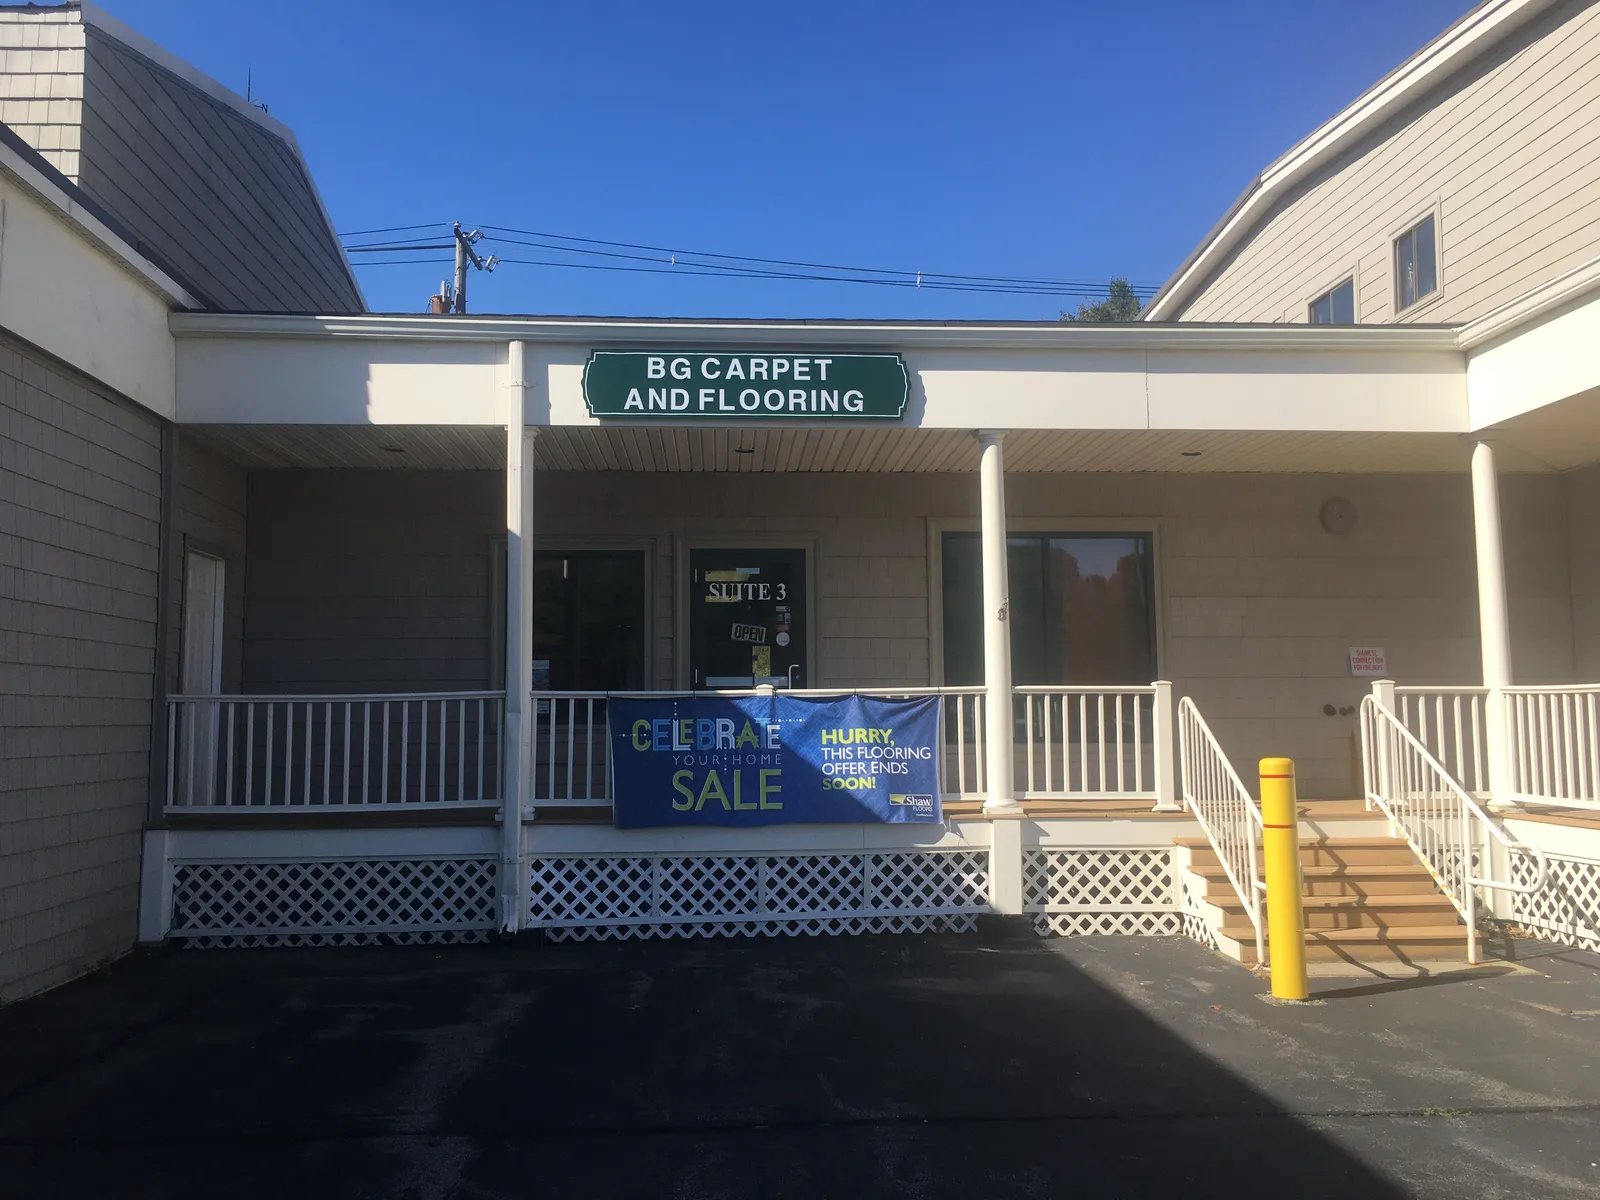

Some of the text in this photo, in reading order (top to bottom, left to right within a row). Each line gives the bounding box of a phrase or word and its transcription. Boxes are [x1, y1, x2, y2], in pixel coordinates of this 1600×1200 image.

[647, 357, 832, 381] BG CARPET
[623, 388, 864, 412] AND FLOORING
[709, 583, 787, 600] SUITE 3
[734, 624, 765, 642] OPEN
[632, 717, 781, 752] CELEBRATE
[821, 728, 895, 747] HURRY,
[672, 753, 782, 766] YOUR HOME
[821, 746, 931, 760] THIS FLOORING
[821, 761, 908, 775] OFFER ENDS
[672, 768, 783, 812] SALE
[822, 776, 876, 791] SOON!
[906, 796, 931, 806] Shaw
